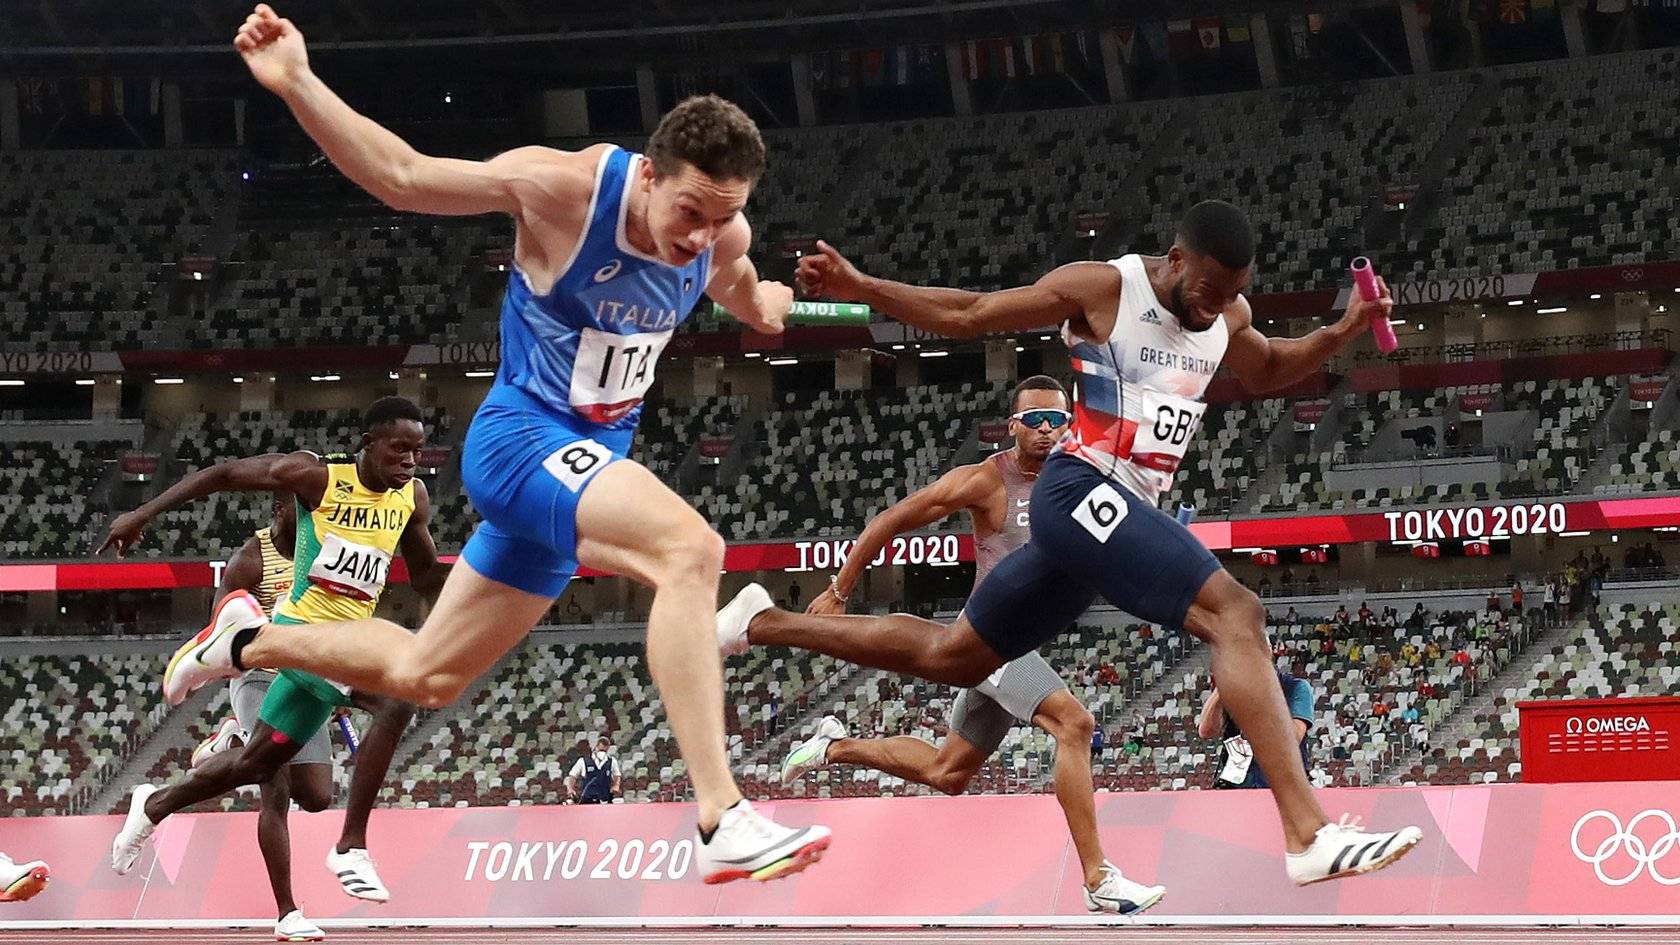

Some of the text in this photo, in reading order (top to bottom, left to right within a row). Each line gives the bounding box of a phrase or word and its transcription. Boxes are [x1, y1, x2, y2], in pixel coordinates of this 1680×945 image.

[1389, 275, 1505, 306] KYO 2020
[595, 300, 676, 328] ITALIA
[37, 352, 92, 371] 2020
[436, 342, 499, 367] TOKY
[598, 345, 651, 390] ITA
[1140, 347, 1178, 368] GREAT
[561, 447, 599, 474] 8
[327, 503, 403, 531] JAMAICA
[1088, 498, 1117, 527] 6
[1384, 503, 1566, 541] TOKYO 2020
[324, 547, 381, 584] JAM
[795, 535, 958, 570] TOK 2020
[1586, 717, 1650, 733] OMEGA
[465, 838, 693, 882] TOKYO 2020
